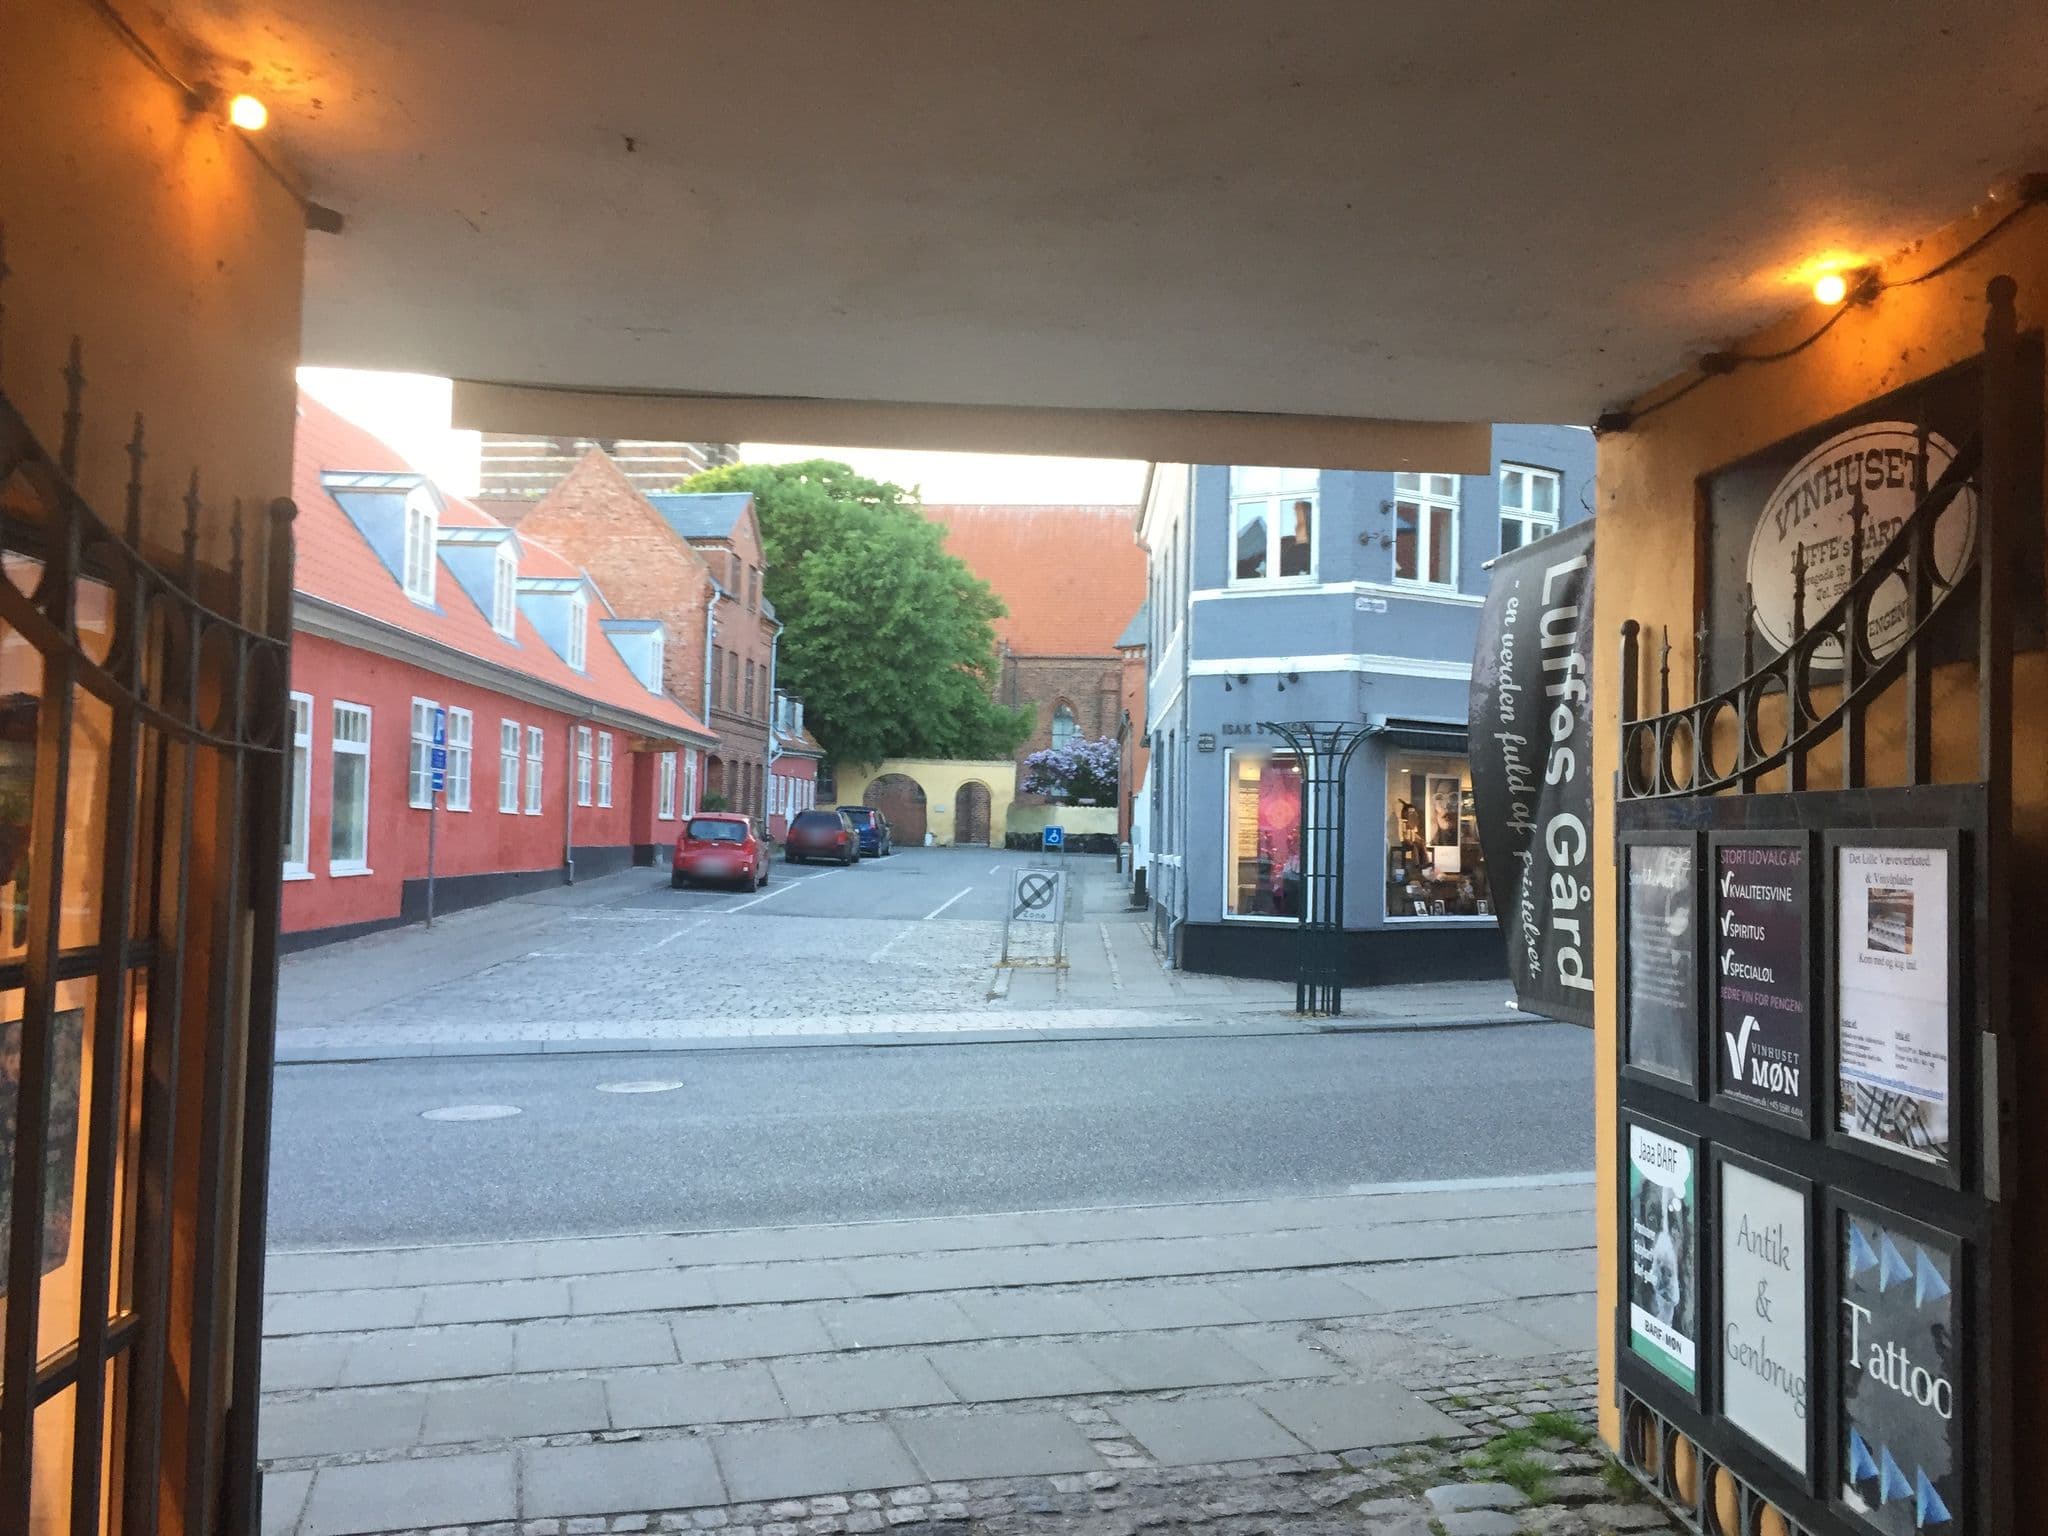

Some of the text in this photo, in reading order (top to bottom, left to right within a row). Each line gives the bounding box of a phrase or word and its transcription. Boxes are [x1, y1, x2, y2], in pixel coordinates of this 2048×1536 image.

[1504, 596, 1520, 628] en
[1499, 632, 1523, 724] verden
[1540, 554, 1588, 787] Luffes
[1494, 732, 1537, 796] fuld
[1720, 849, 1802, 867] STORT UDVALG AF
[1545, 812, 1595, 991] Gård
[1729, 884, 1793, 903] KVALITETSVINE
[1023, 911, 1046, 919] Zone
[1729, 923, 1766, 941] SPIRITUS
[1729, 962, 1776, 984] SPECIALØL
[1755, 992, 1770, 1007] FOR
[1751, 1042, 1800, 1065] VINHUSET
[1751, 1057, 1800, 1097] MØN
[1639, 1135, 1678, 1174] Jaaa BARF
[1737, 1213, 1792, 1272] Antik
[1755, 1277, 1773, 1323] &
[1725, 1322, 1806, 1419] Genbrug
[1842, 1297, 1953, 1419] Tattoo
